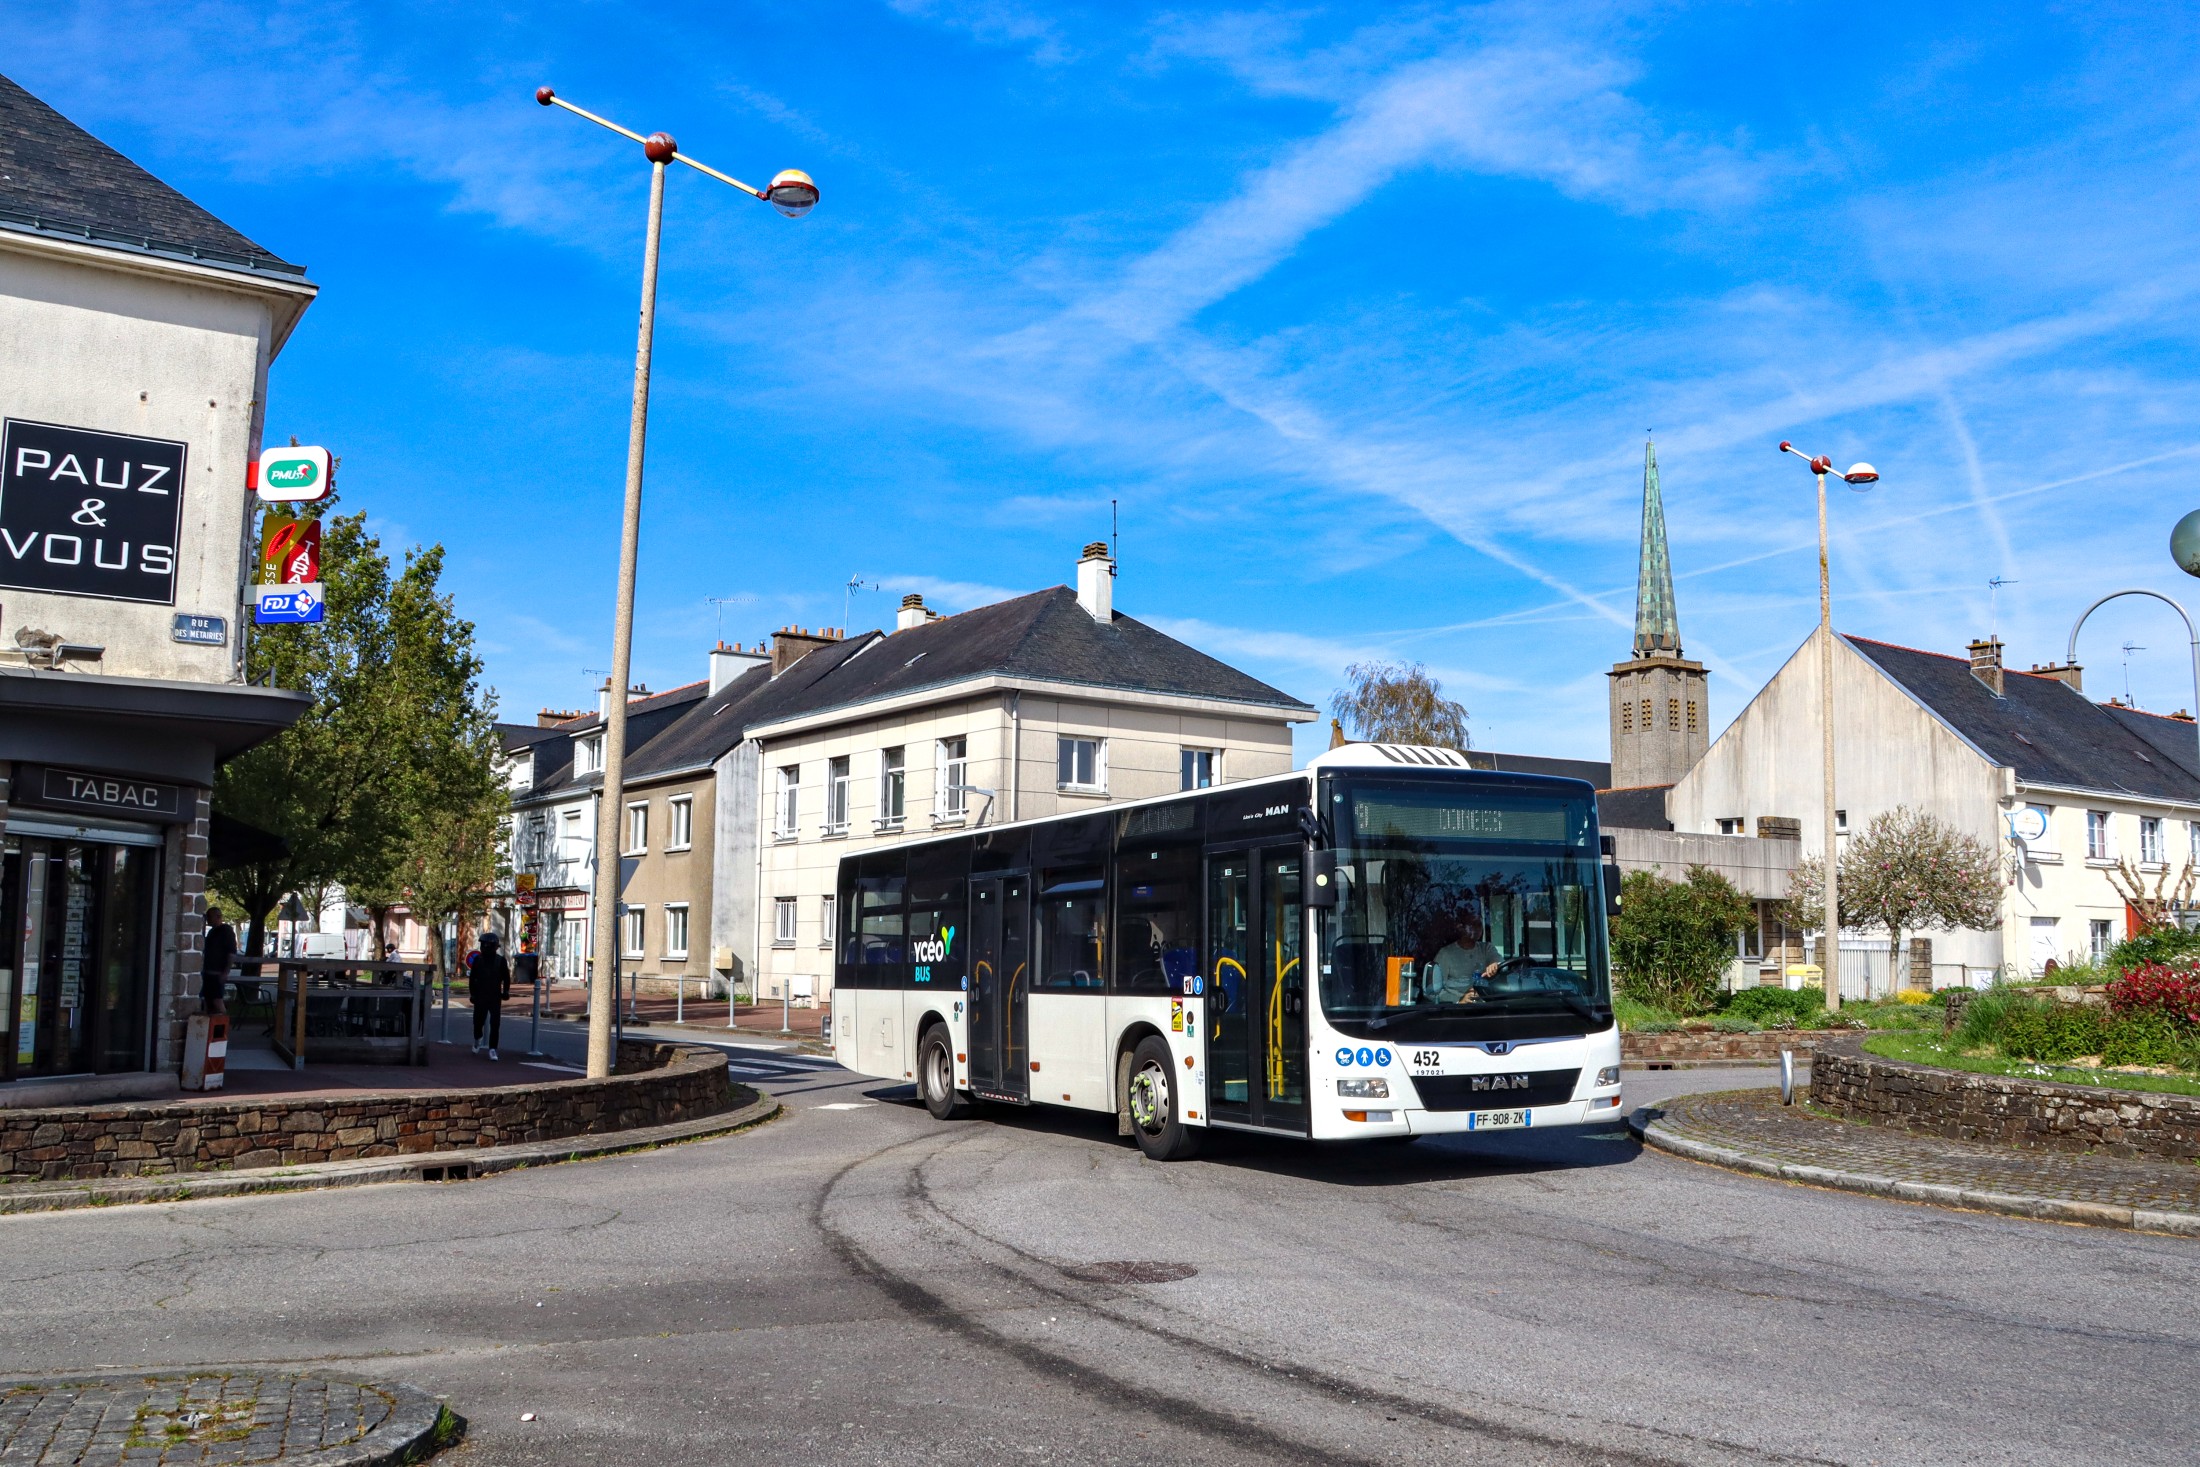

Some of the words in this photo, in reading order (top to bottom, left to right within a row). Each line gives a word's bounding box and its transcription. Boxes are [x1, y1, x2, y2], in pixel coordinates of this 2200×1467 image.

[16, 447, 171, 496] PAUZ
[71, 498, 107, 528] &
[0, 528, 173, 575] VOUS
[288, 540, 315, 584] TABA
[264, 597, 290, 610] FDJ
[191, 619, 209, 628] RUE
[174, 629, 188, 638] DES
[67, 777, 158, 807] TABAC
[1265, 804, 1289, 817] MAN
[915, 966, 930, 982] BUS
[1413, 1051, 1440, 1066] 452
[1470, 1074, 1529, 1091] MAN
[1476, 1111, 1524, 1126] FF-908-ZK
